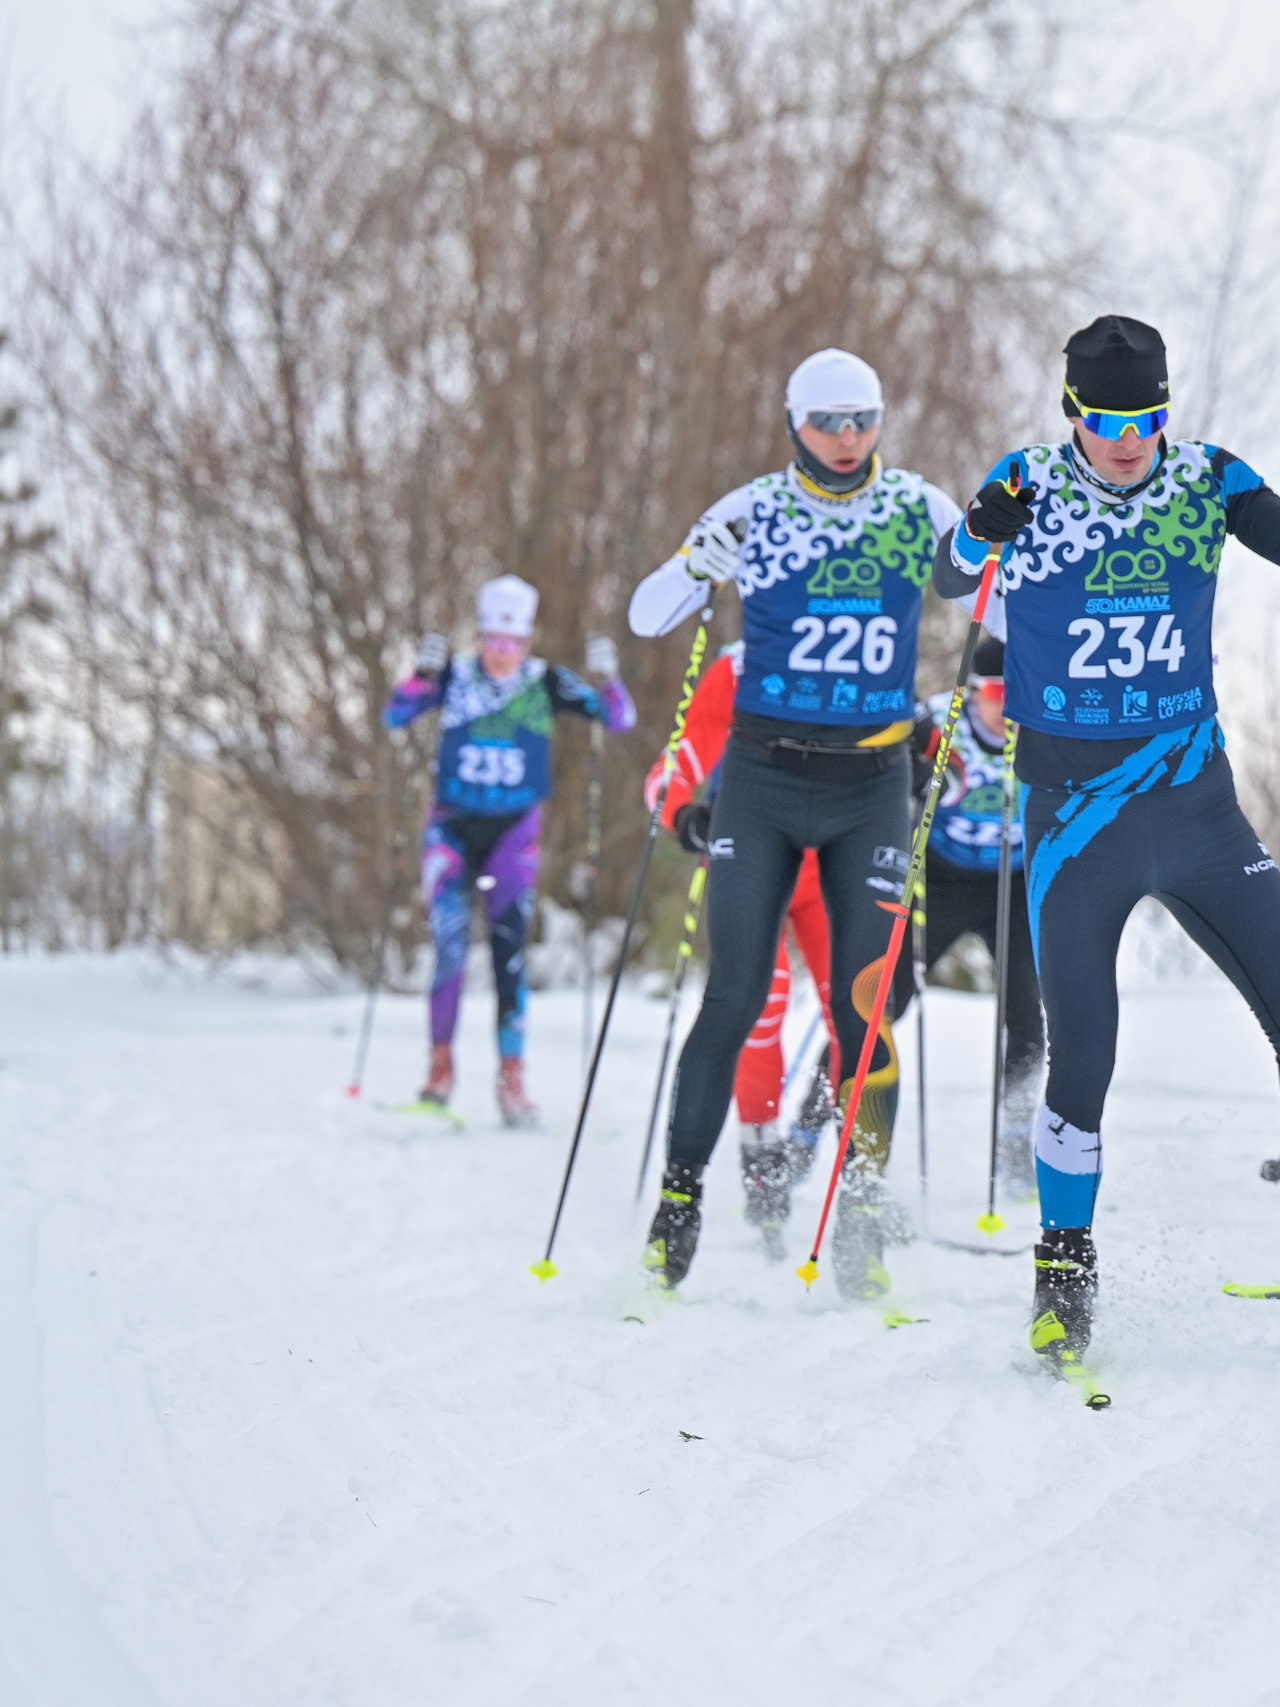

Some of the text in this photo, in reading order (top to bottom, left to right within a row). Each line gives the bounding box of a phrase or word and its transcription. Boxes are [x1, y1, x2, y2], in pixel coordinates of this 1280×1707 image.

[1085, 548, 1167, 595] 400
[1114, 594, 1171, 611] KAMAZ
[788, 615, 899, 675] 226
[1067, 614, 1186, 679] 234
[1159, 685, 1202, 708] RUSSIA
